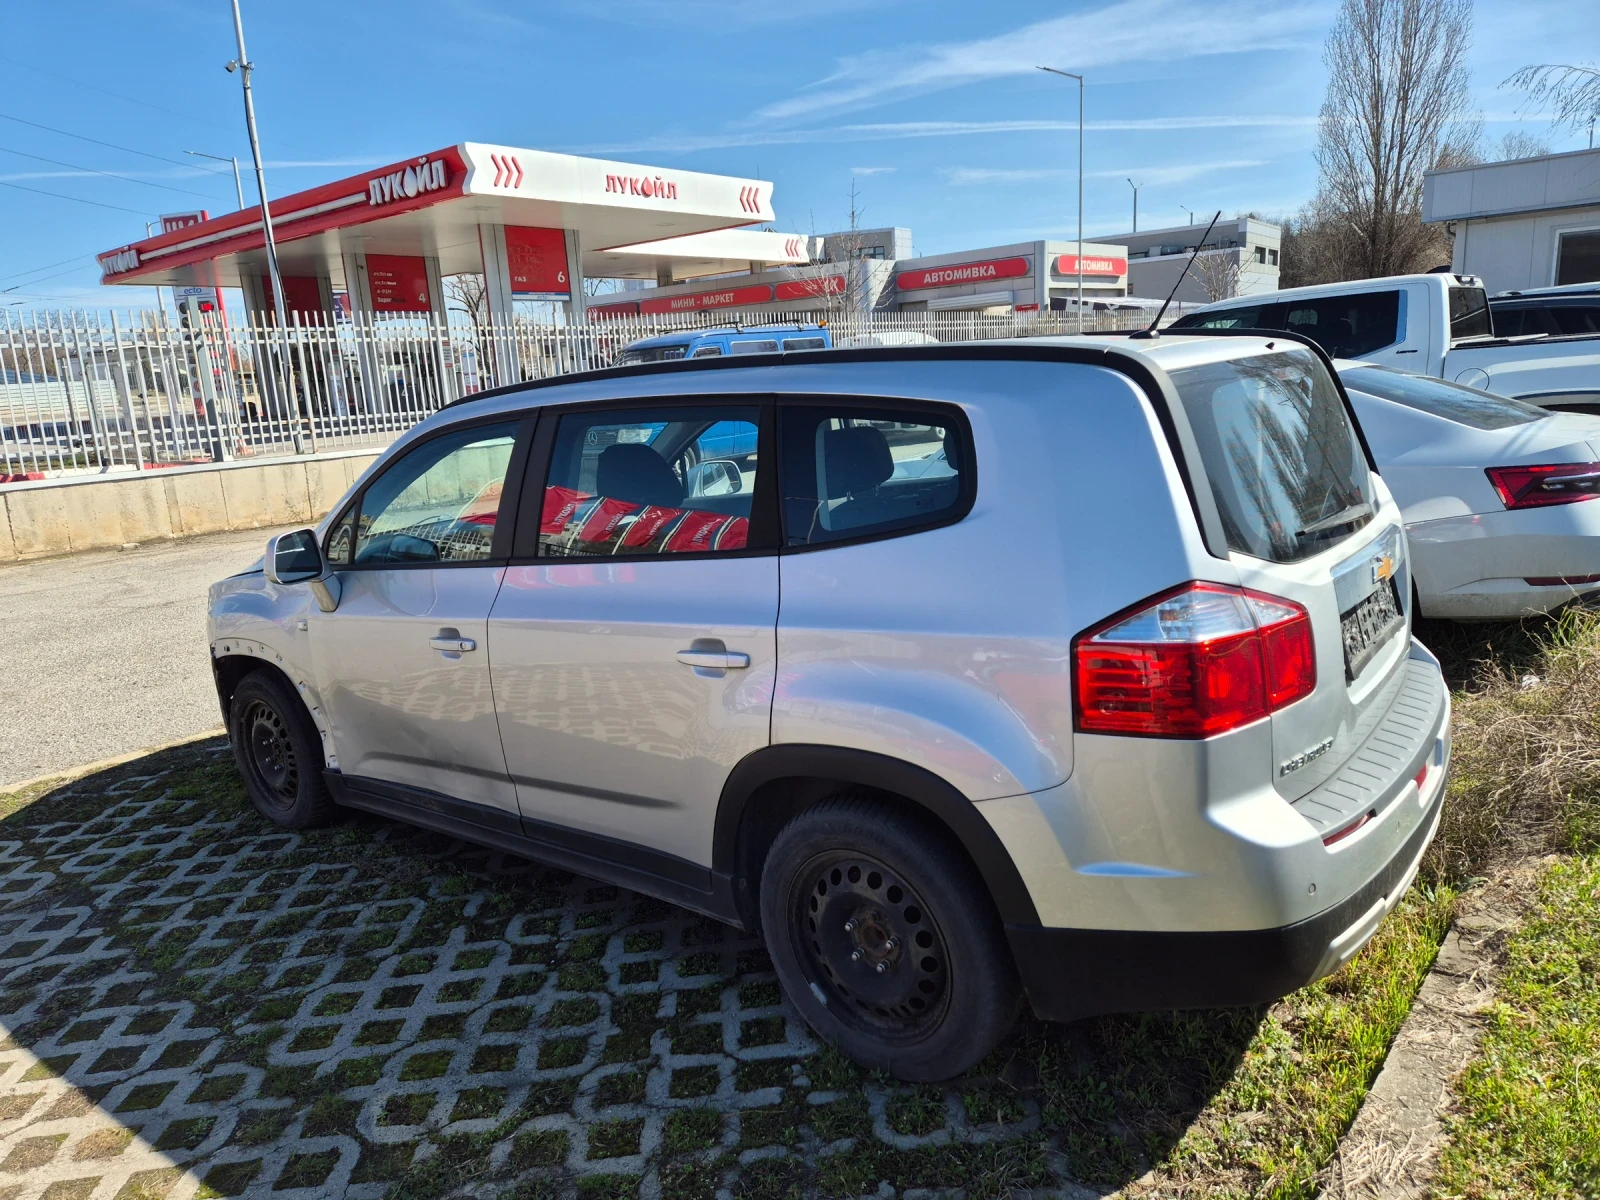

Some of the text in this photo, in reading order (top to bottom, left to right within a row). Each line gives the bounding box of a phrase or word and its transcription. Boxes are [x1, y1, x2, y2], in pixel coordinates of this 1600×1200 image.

[369, 157, 446, 206] ЛУКОЙЛ
[605, 174, 677, 200] ЛУКОЙЛ
[557, 271, 566, 283] 6
[924, 265, 996, 284] АВТОМИВКА
[183, 287, 202, 295] ecto
[418, 293, 427, 303] 4
[671, 297, 695, 309] МИНИ
[702, 293, 734, 306] МАРКЕТ
